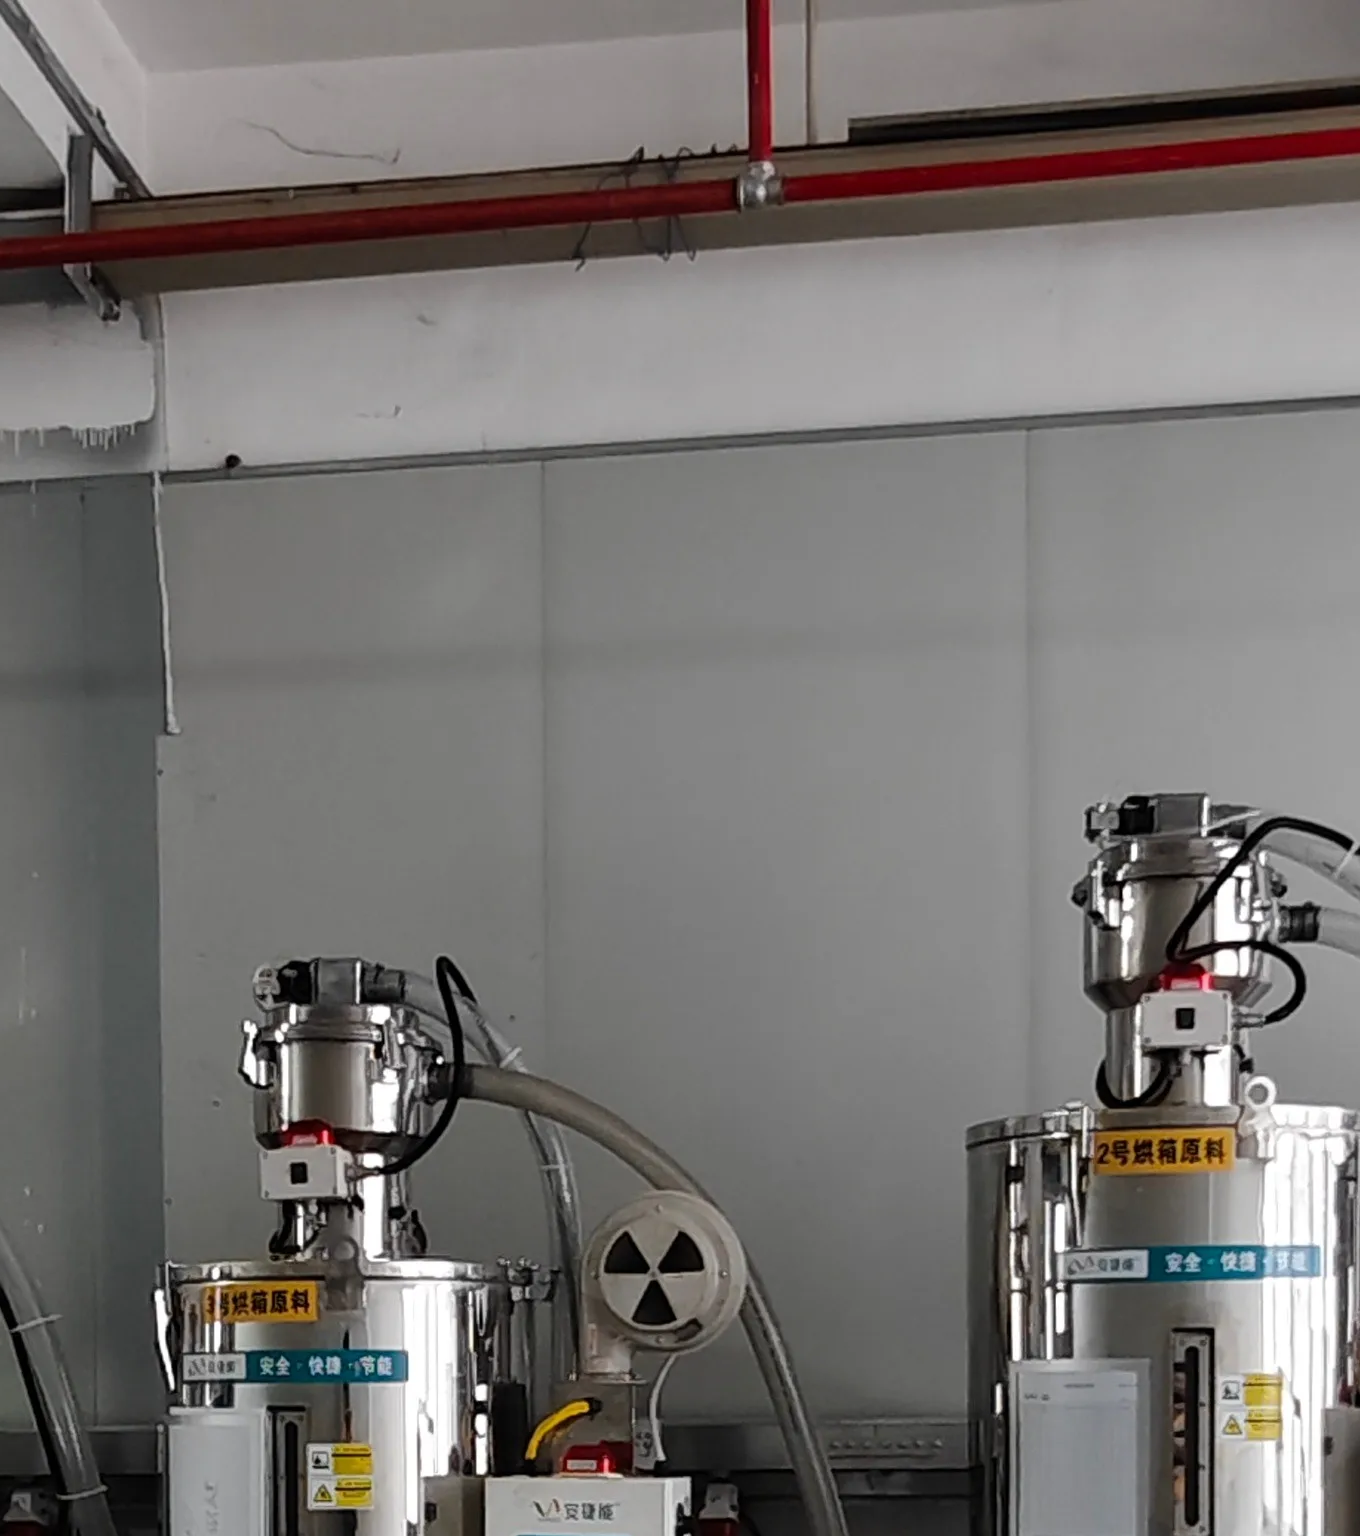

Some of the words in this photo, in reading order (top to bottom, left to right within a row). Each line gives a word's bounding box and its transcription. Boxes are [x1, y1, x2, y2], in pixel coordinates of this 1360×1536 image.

[1096, 1137, 1227, 1166] 2号烘箱原料
